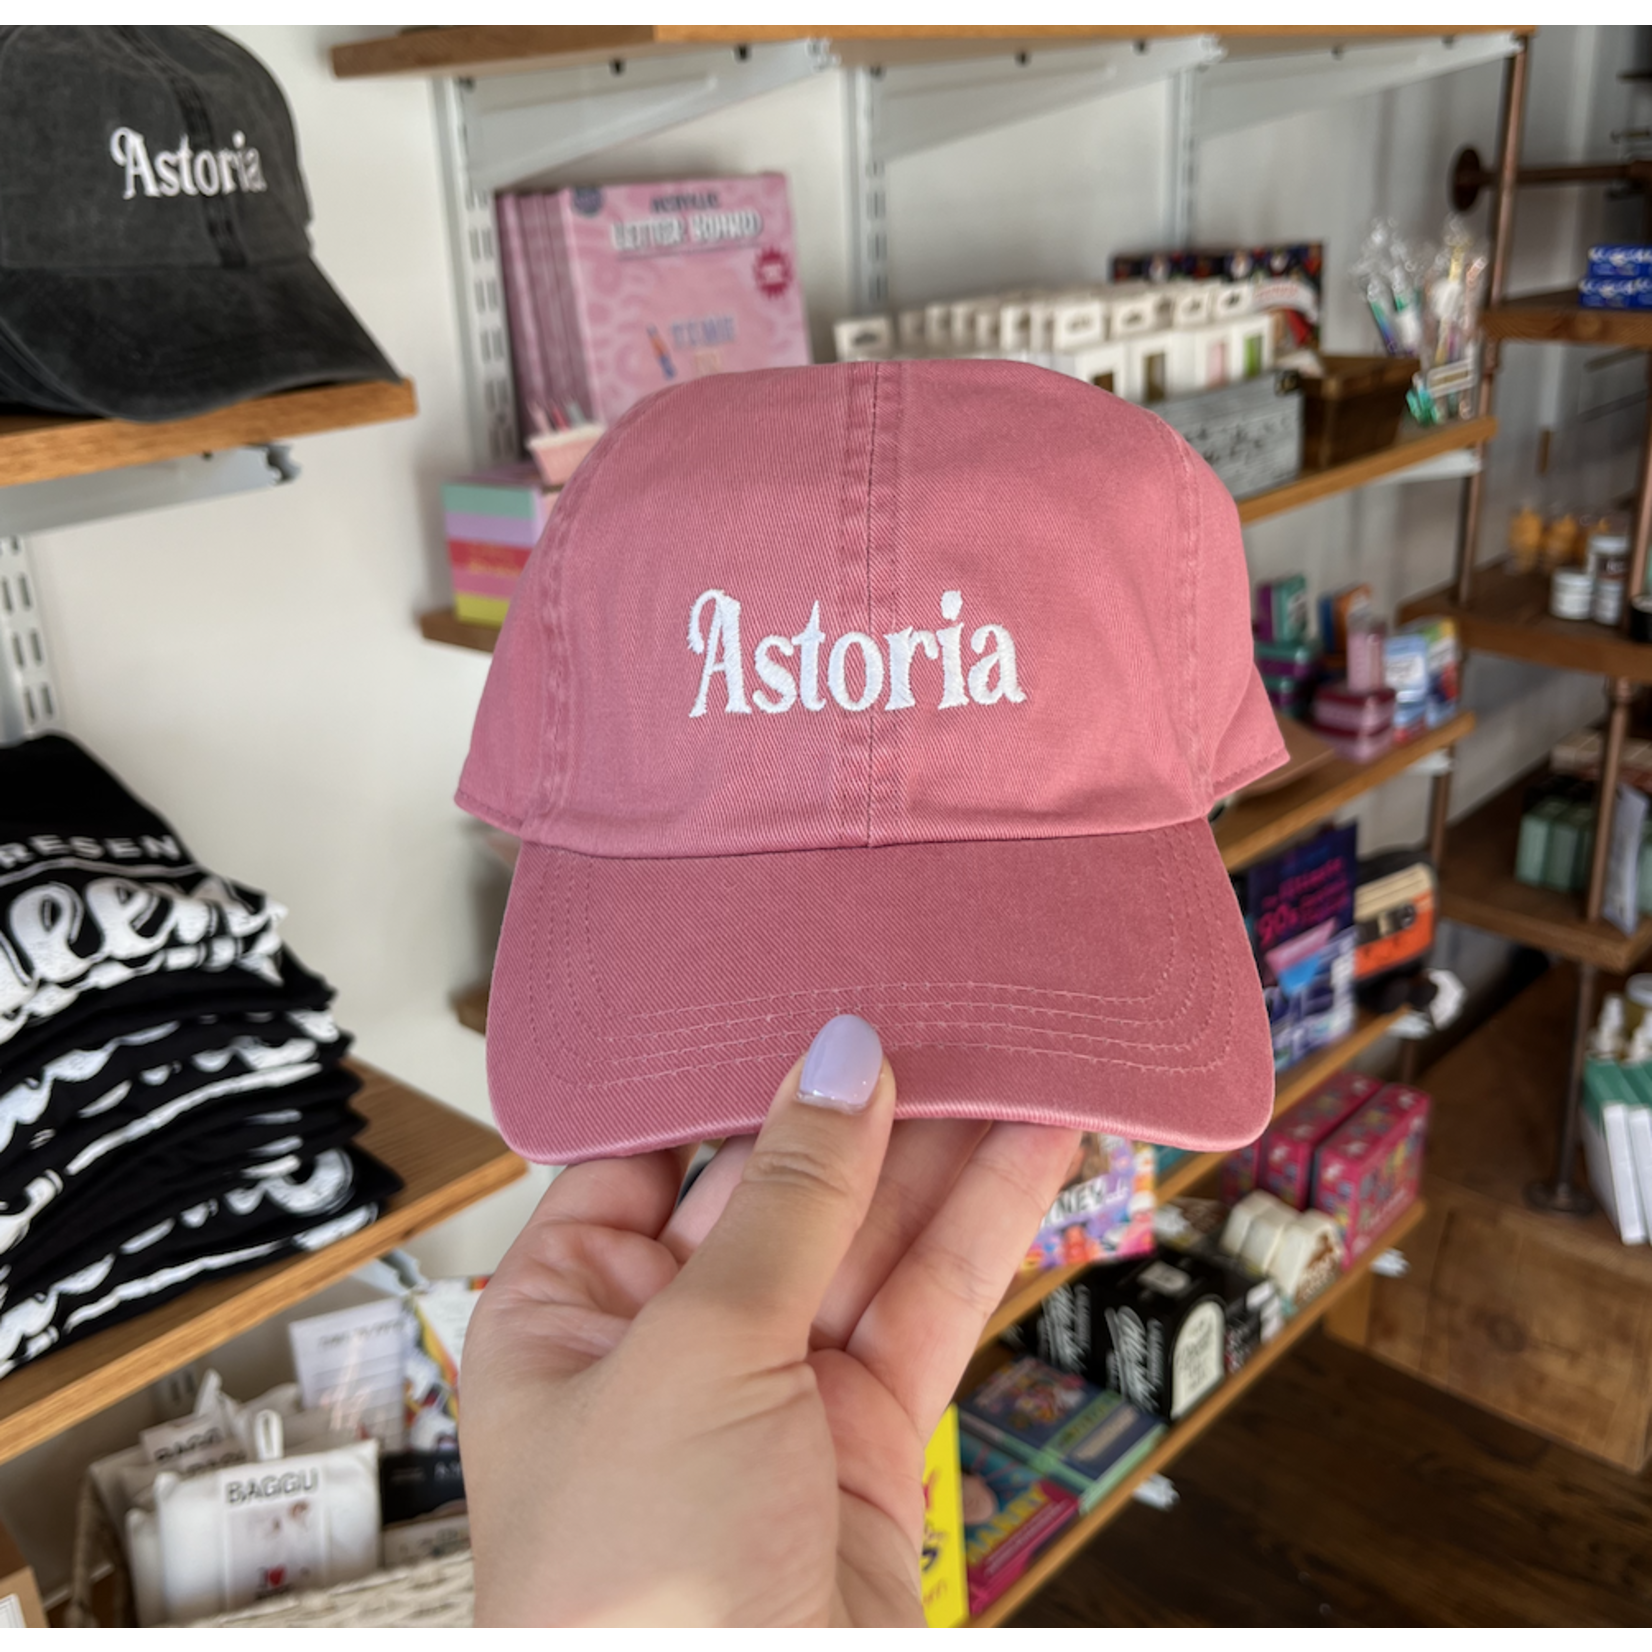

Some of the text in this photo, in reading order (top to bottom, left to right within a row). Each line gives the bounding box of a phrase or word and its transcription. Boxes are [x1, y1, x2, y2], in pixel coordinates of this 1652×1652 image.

[109, 126, 267, 200] Astoria
[687, 588, 1028, 719] Astoria
[226, 1468, 319, 1504] BAGGU
